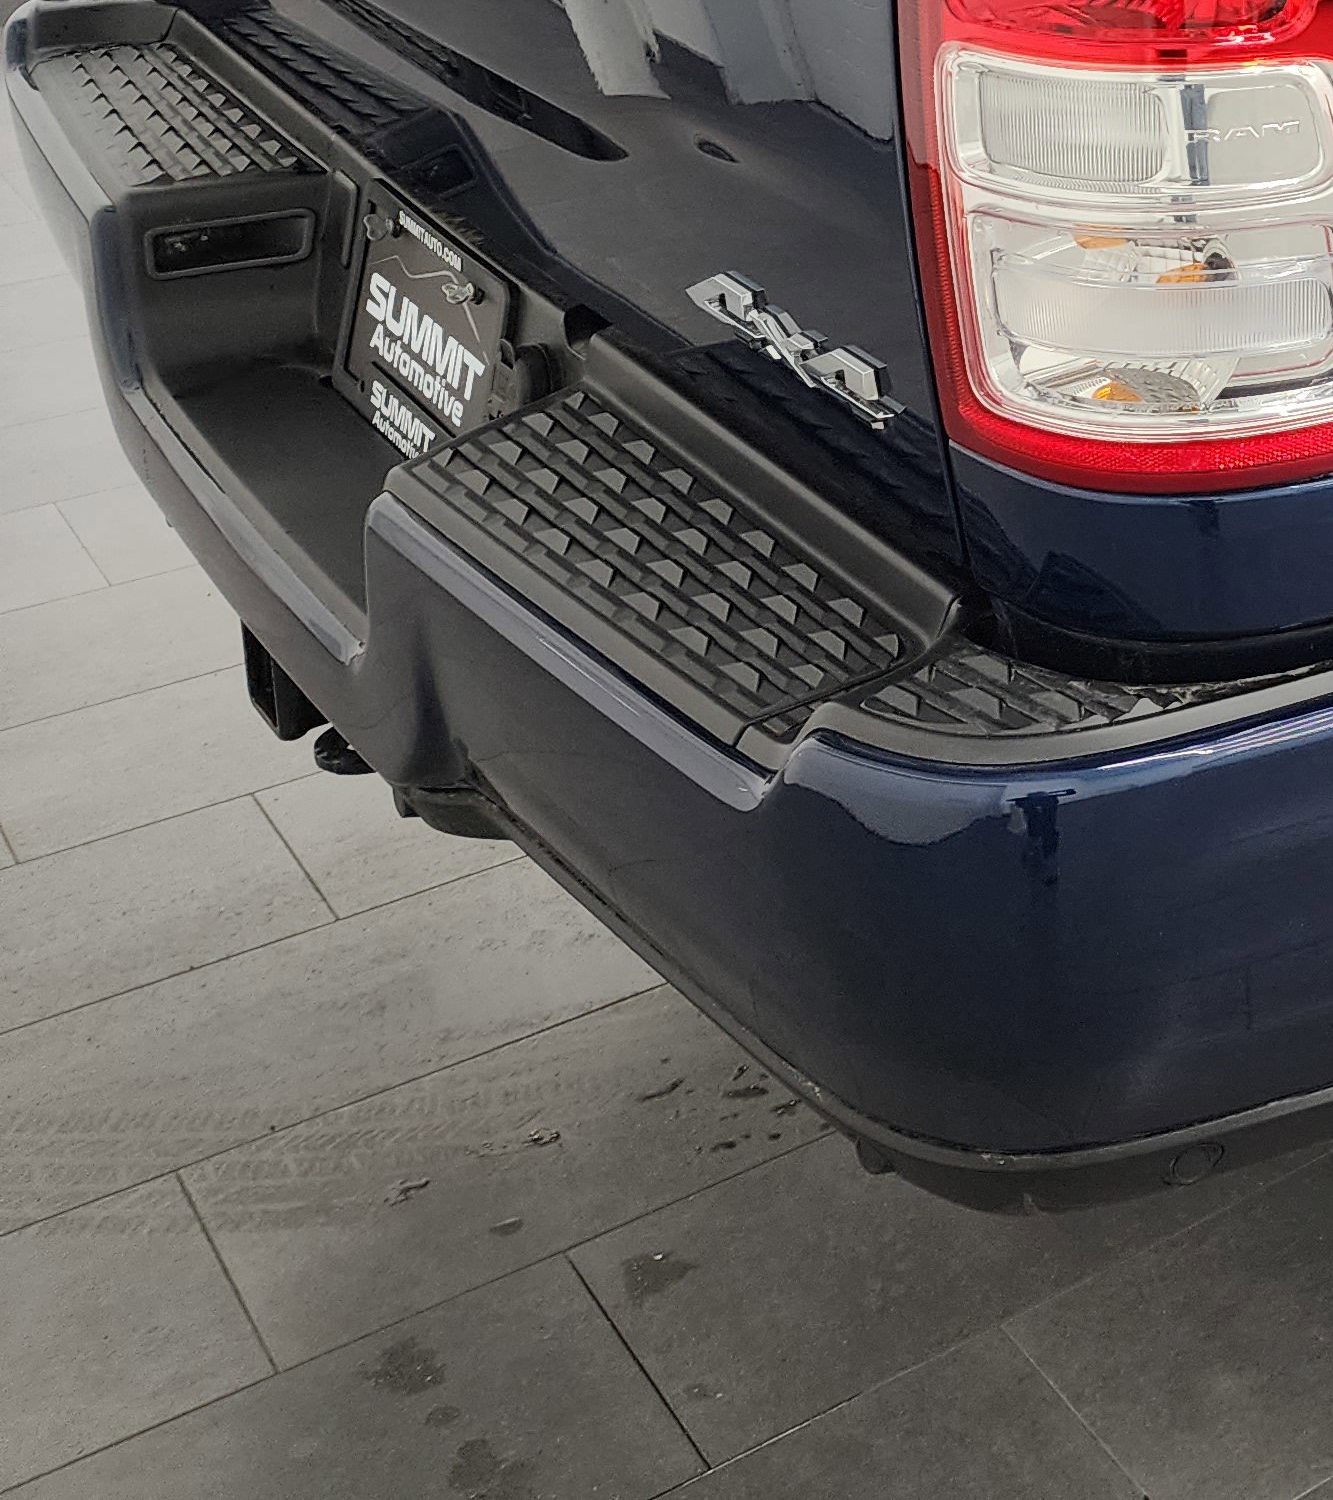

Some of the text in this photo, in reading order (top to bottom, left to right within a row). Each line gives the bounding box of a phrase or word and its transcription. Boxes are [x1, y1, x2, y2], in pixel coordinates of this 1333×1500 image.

[1184, 120, 1300, 148] RAM
[365, 272, 485, 401] SUMMIT
[369, 322, 464, 427] Automotive
[370, 380, 436, 453] SUMMIT
